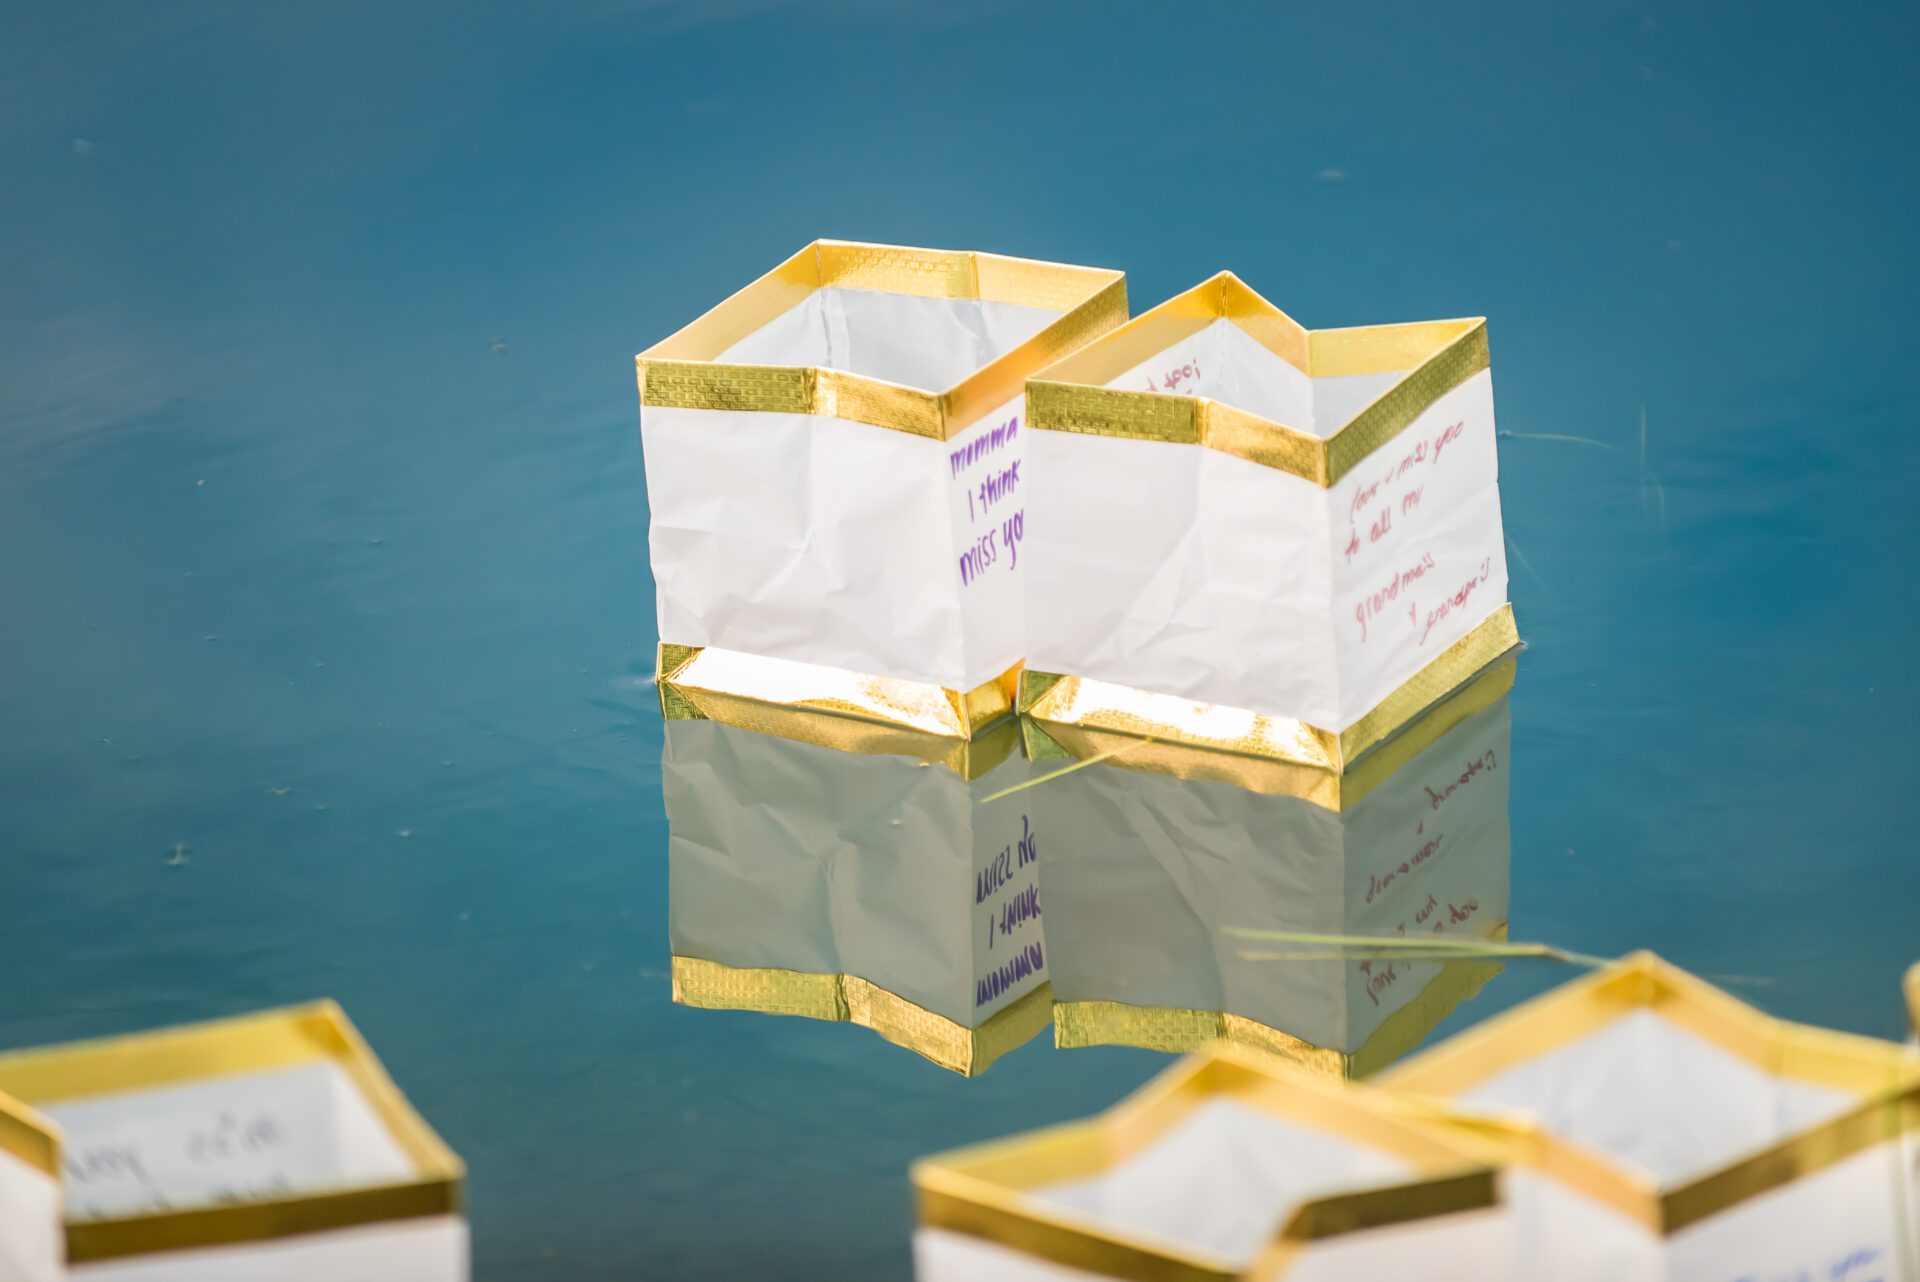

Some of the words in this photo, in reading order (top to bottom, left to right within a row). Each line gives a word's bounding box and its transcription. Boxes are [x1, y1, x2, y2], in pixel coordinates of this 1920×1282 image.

[950, 416, 1018, 480] momma
[979, 459, 1021, 515] think
[960, 528, 997, 587] miss
[1003, 508, 1024, 571] yo
[1370, 505, 1391, 542] all
